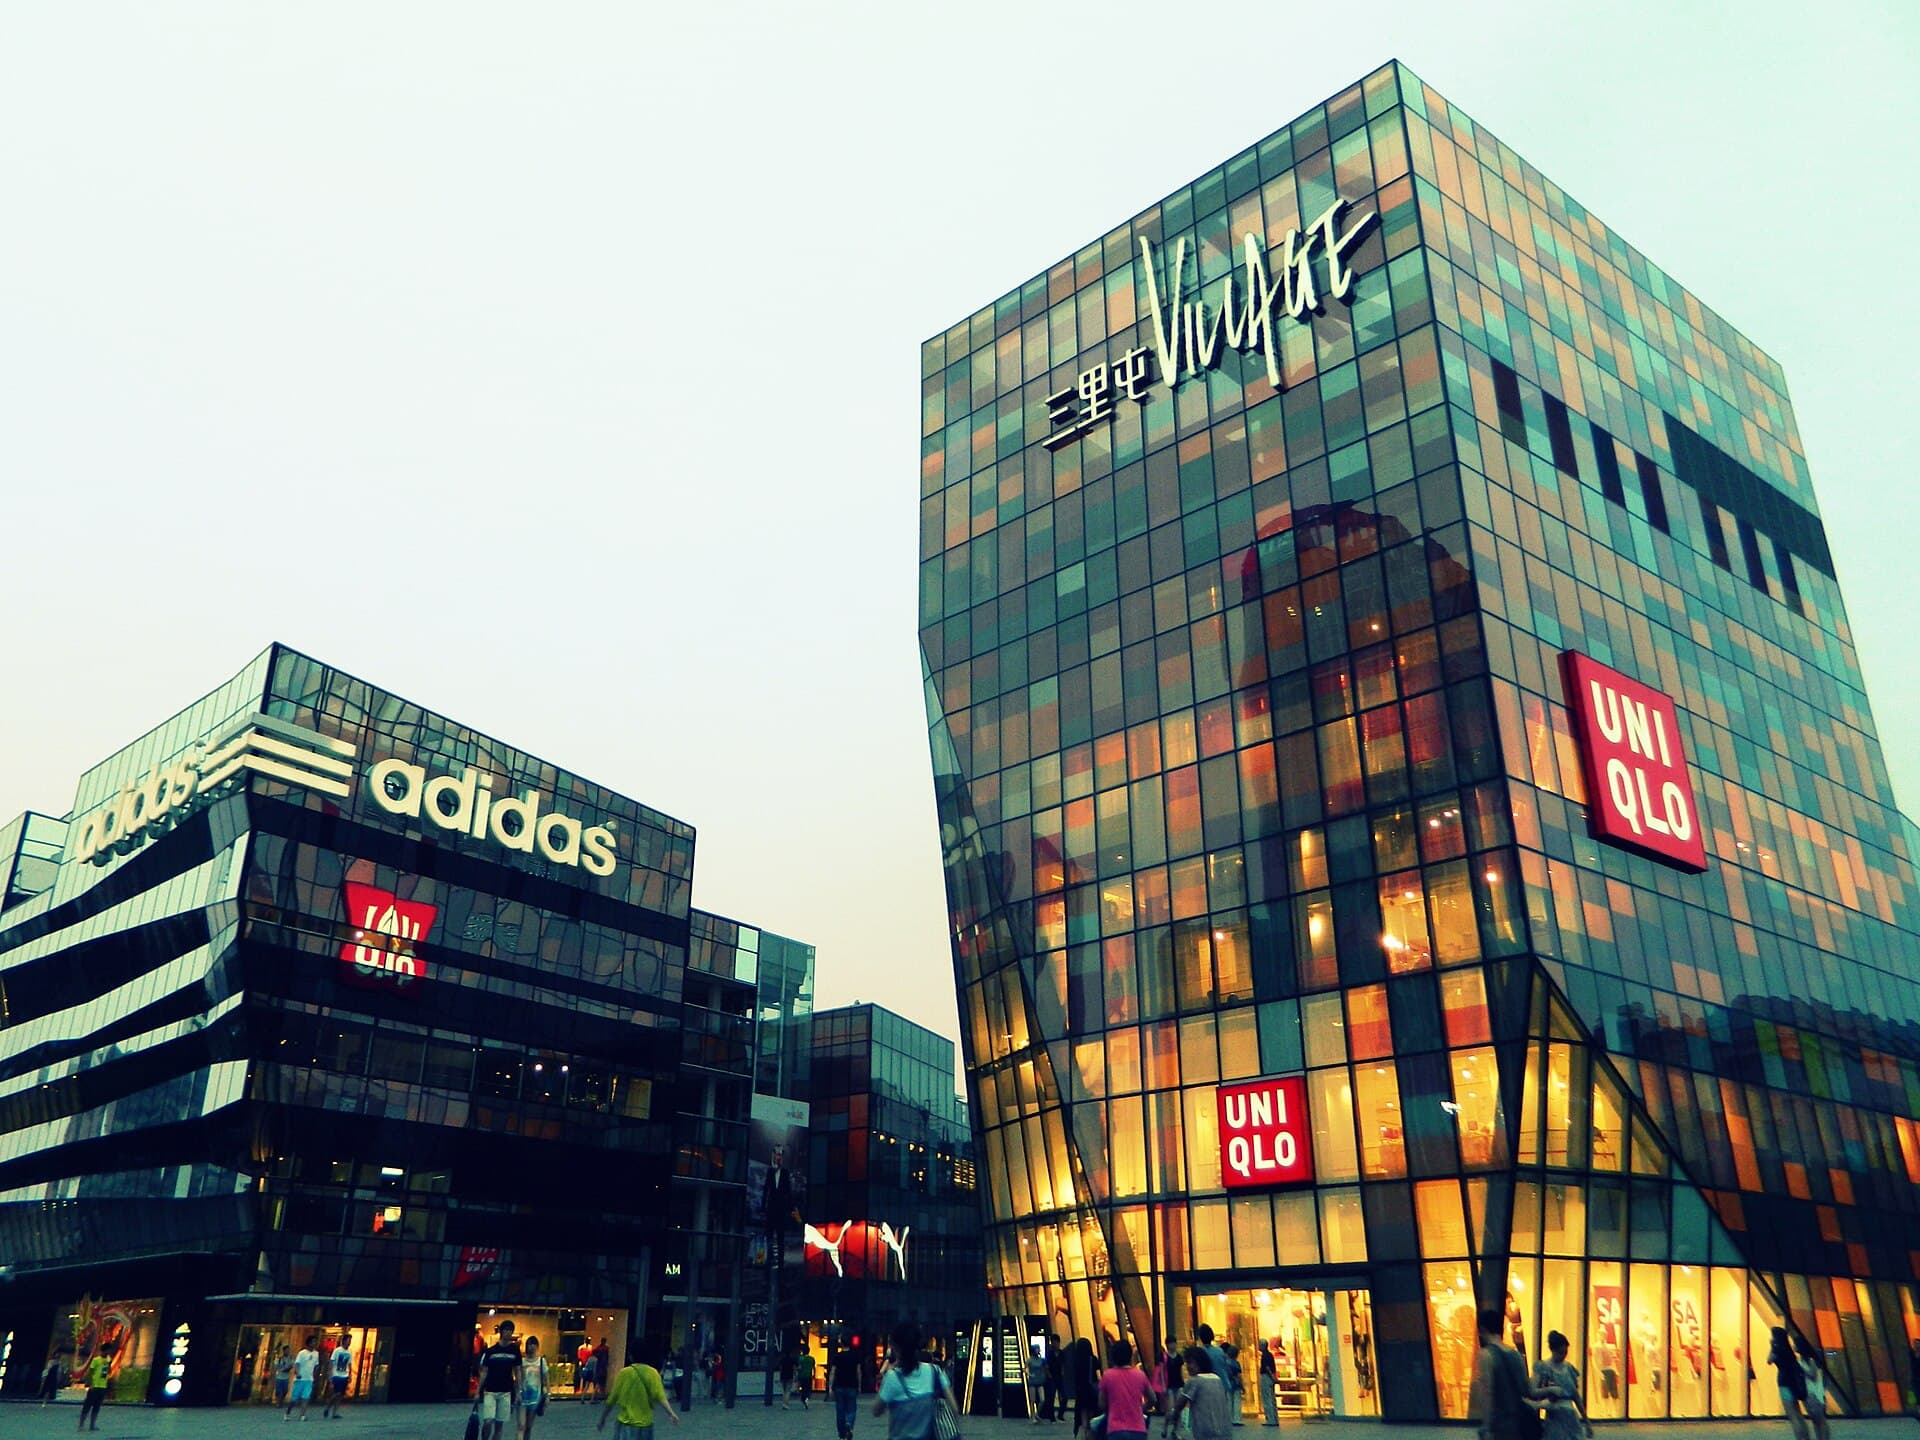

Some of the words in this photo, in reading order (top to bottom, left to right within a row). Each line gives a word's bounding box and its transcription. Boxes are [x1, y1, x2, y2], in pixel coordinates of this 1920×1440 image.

[1042, 345, 1151, 450] 三里屯
[1590, 680, 1672, 767] UNI
[76, 750, 199, 864] adidas
[367, 758, 617, 876] adidas
[1606, 758, 1691, 841] QLO
[1225, 1088, 1288, 1129] UNI
[1228, 1131, 1296, 1177] QLO
[1672, 1300, 1698, 1324] SA
